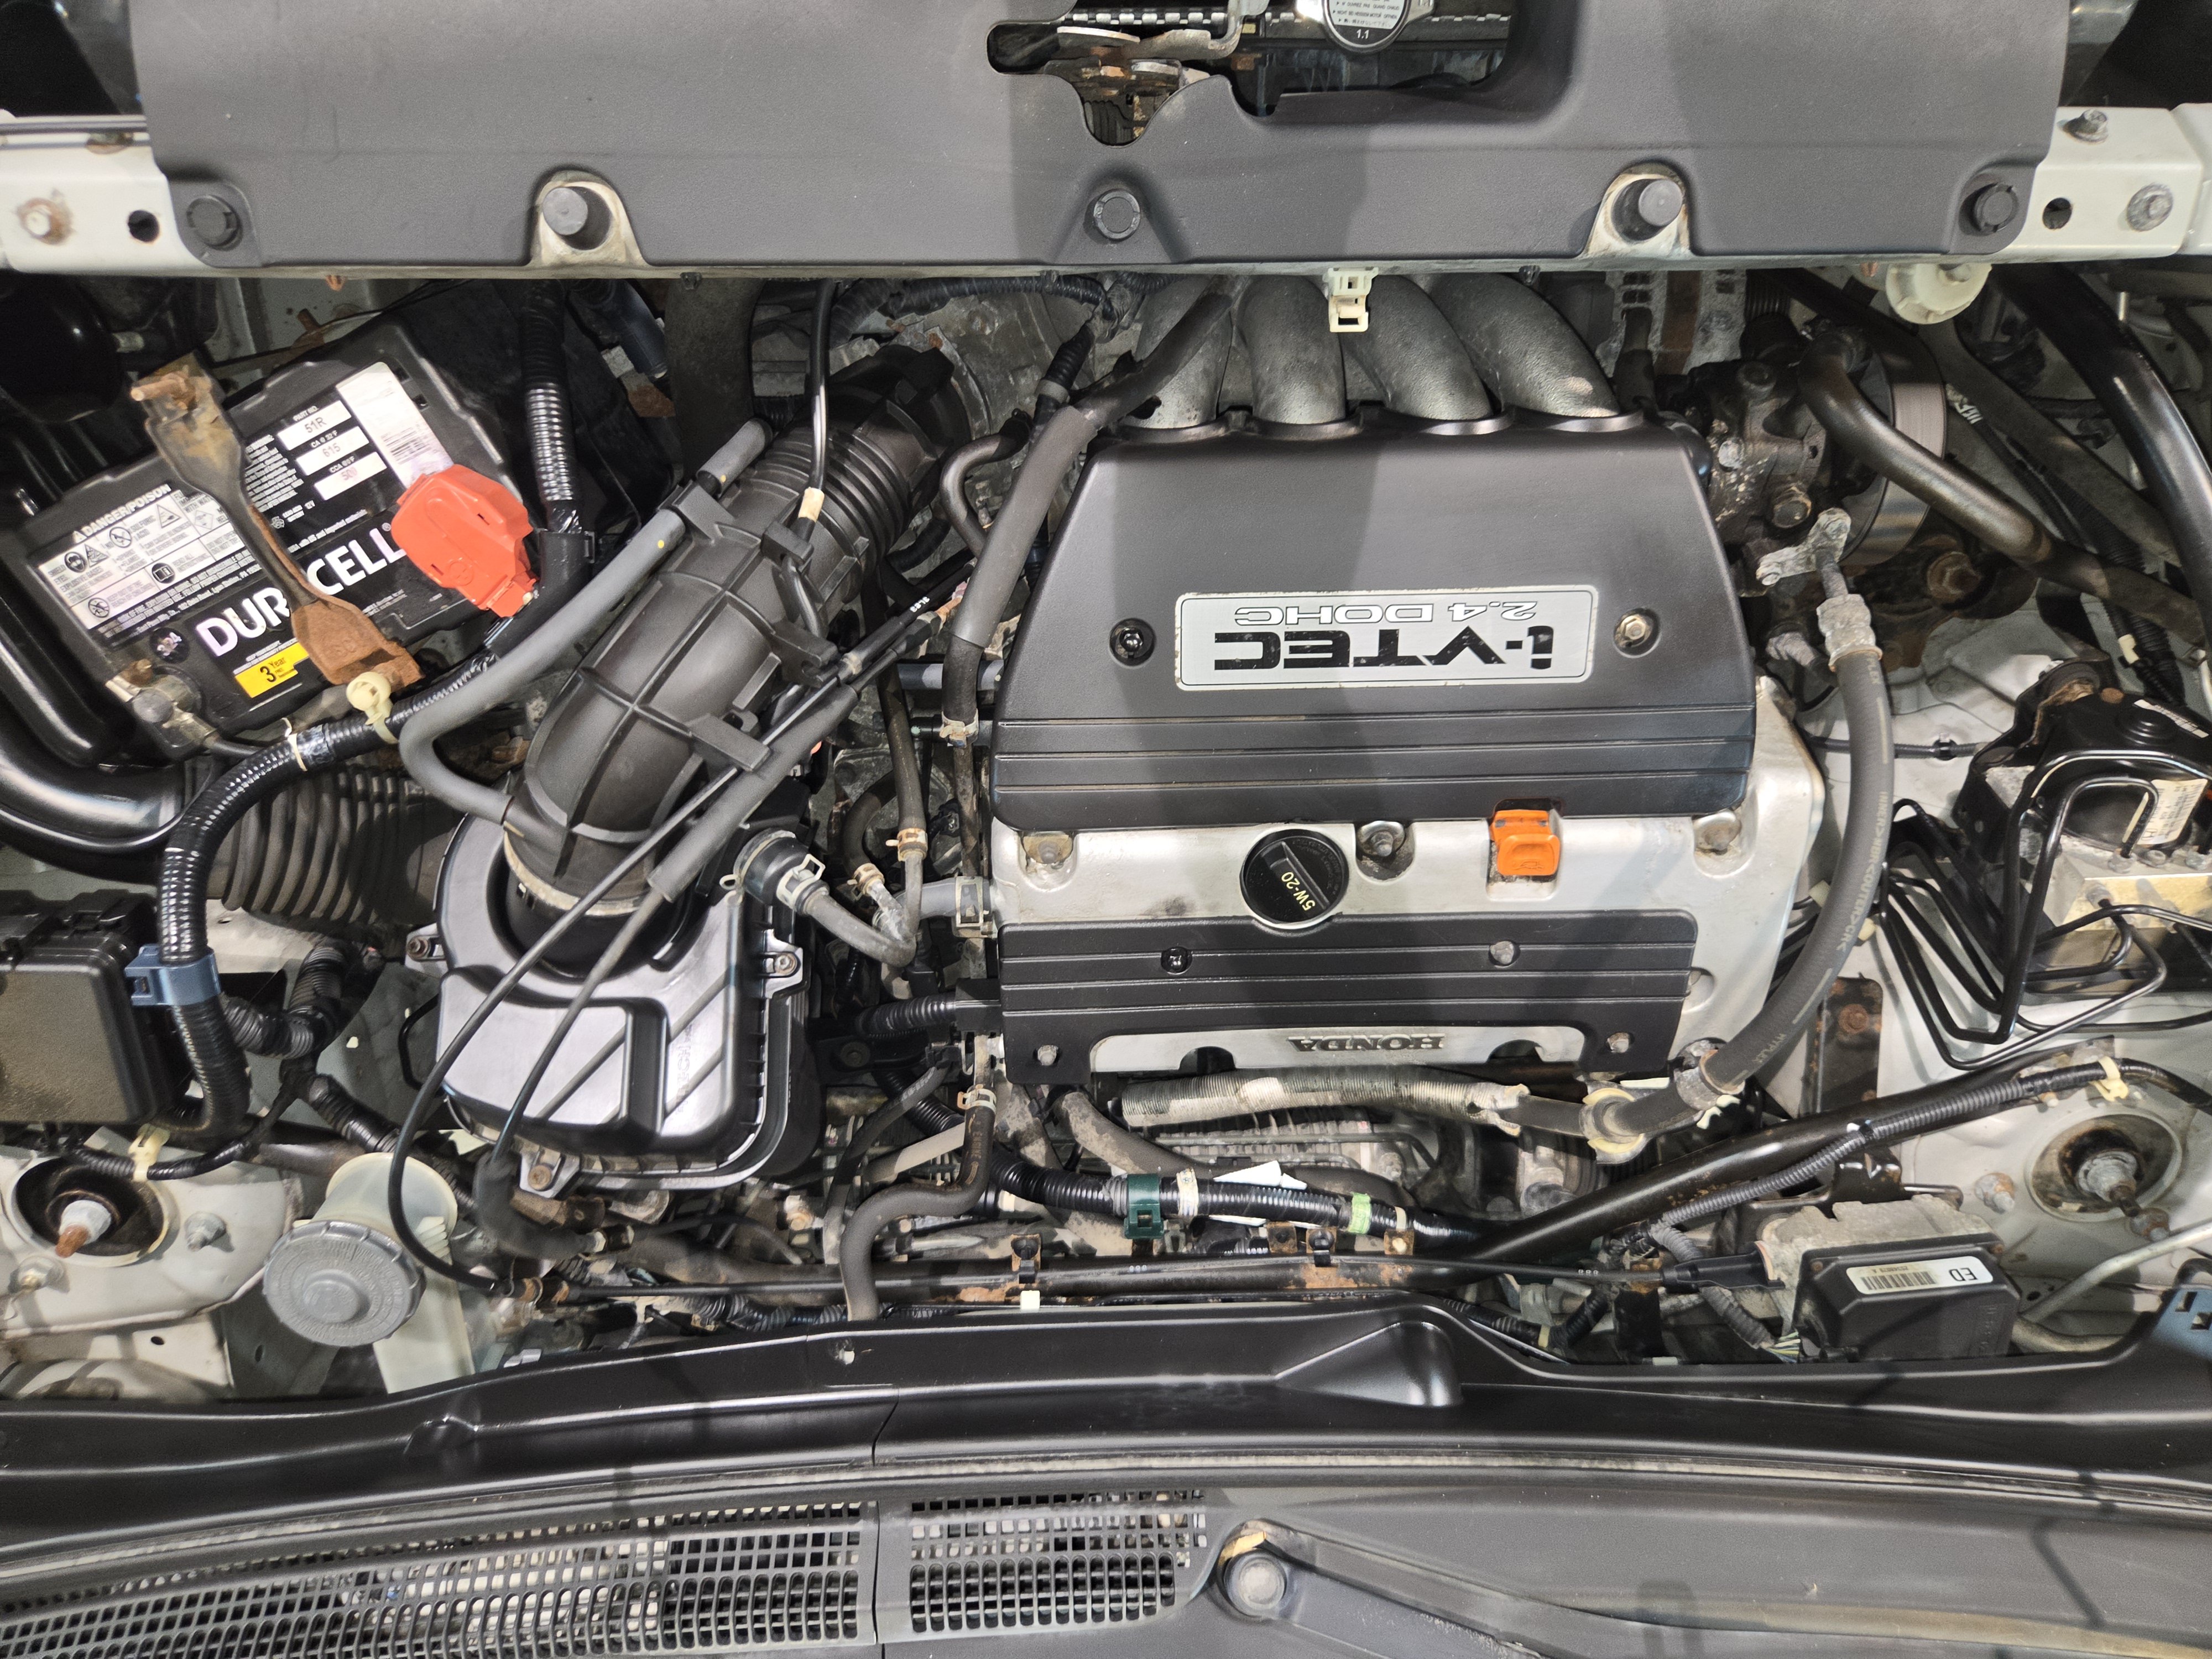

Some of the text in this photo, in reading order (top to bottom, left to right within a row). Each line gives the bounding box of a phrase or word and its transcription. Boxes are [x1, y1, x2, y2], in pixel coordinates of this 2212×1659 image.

[1357, 29, 1369, 39] 1.1
[292, 410, 309, 421] PART
[304, 416, 327, 433] 51R
[310, 439, 321, 448] CA
[322, 442, 342, 457] 615
[328, 463, 343, 473] CCA
[80, 482, 173, 538] DANGER/POISON
[304, 500, 315, 509] 12V
[192, 523, 409, 658] DURCELL
[1234, 601, 1537, 626] 2.4 DOHC
[1214, 625, 1554, 671] i-VTEC
[258, 655, 286, 683] 3 Year
[1279, 870, 1316, 911] 5W-20
[1286, 1033, 1446, 1052] HONDA
[1949, 1267, 1978, 1282] ED
